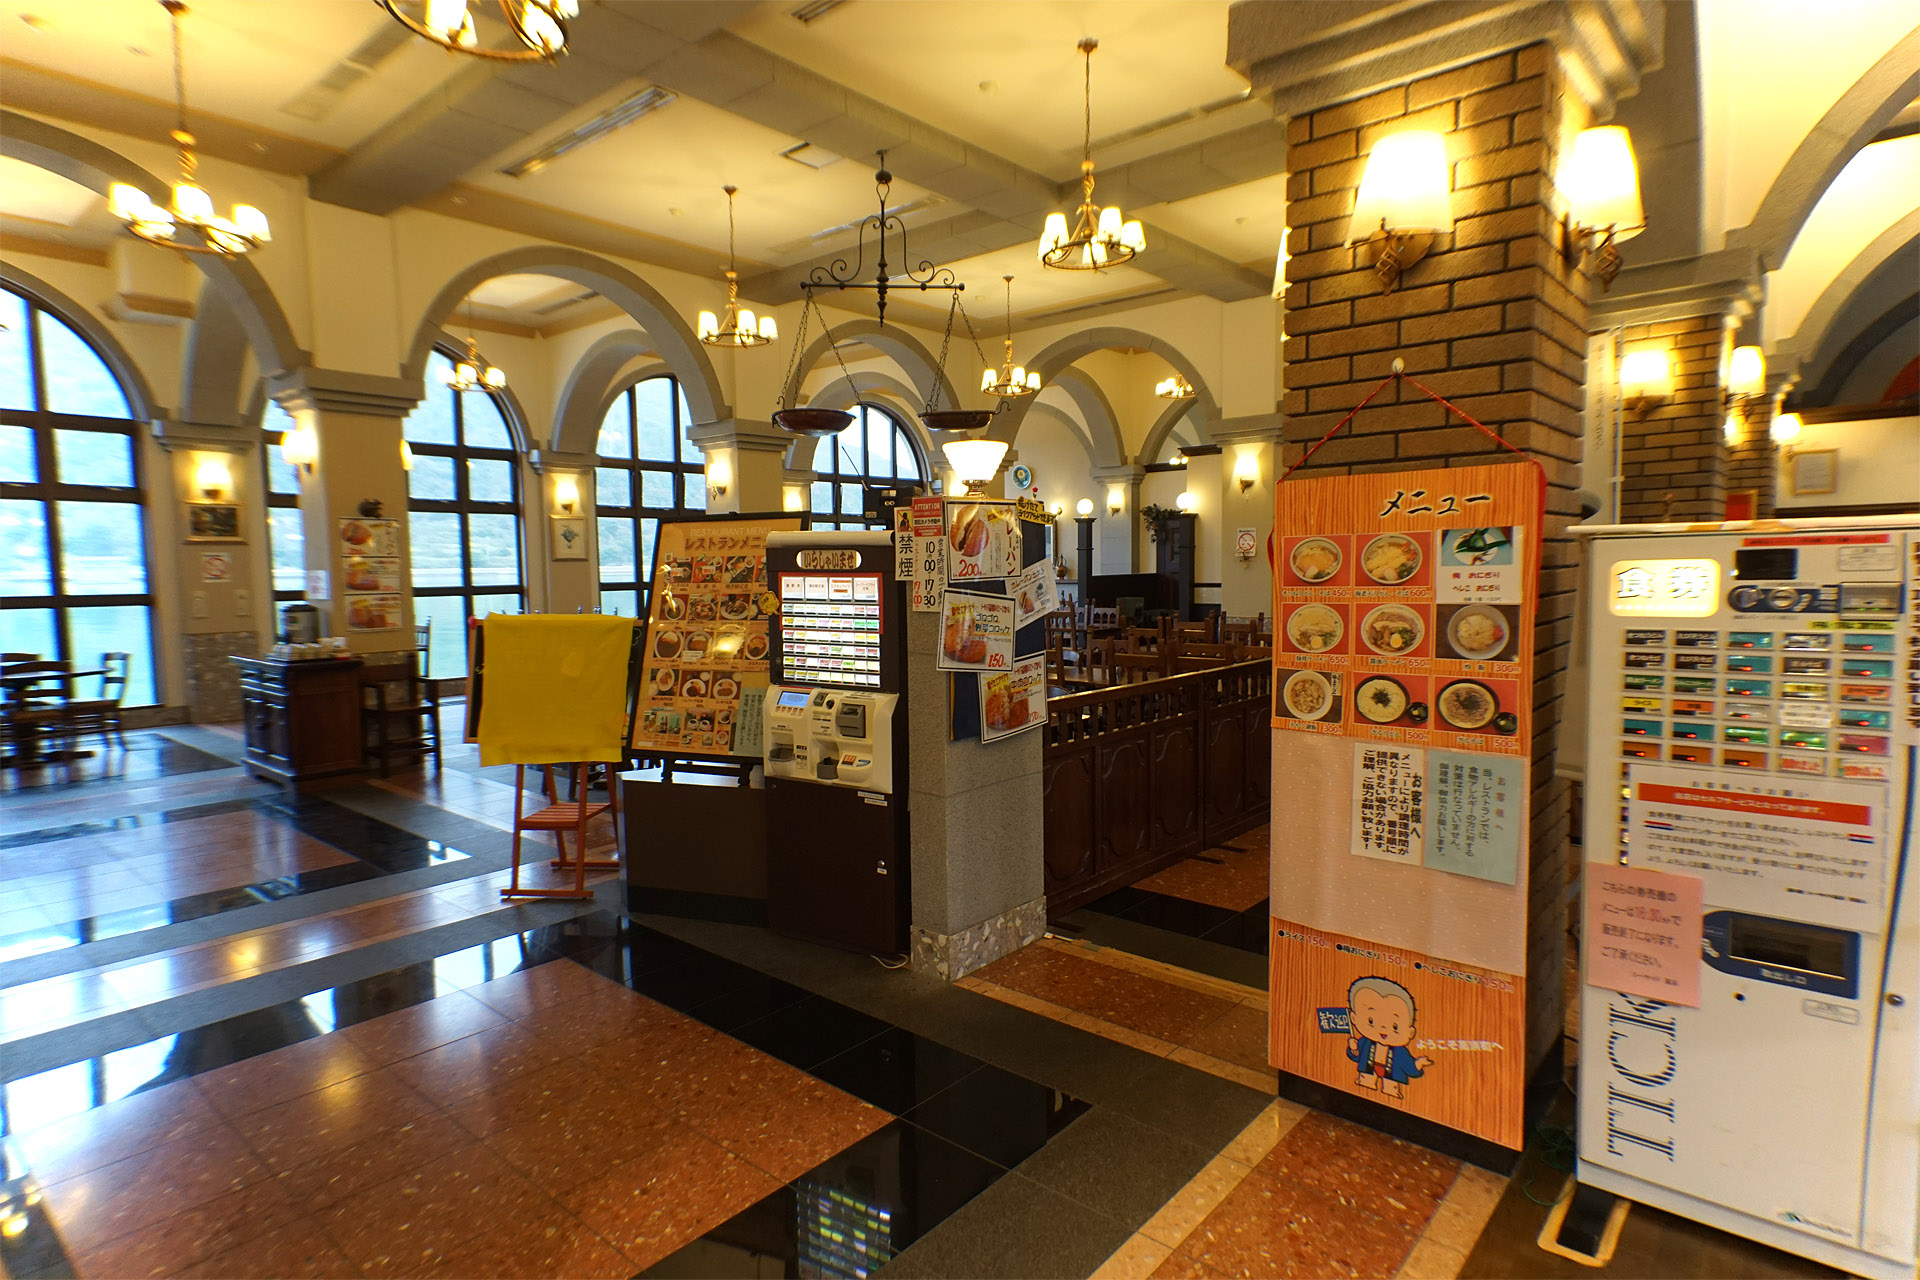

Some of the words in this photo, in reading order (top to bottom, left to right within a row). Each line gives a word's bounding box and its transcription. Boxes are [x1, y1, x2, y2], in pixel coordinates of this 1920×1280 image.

[914, 503, 940, 511] ATTENTION
[1380, 490, 1492, 516] メニュー
[899, 534, 913, 577] 禁煙
[1616, 567, 1709, 599] 食券
[976, 613, 999, 622] ゴロゴロ
[976, 624, 1011, 634] 野菜コロッケ
[1411, 772, 1422, 839] お客様へ
[1285, 931, 1306, 943] ライス
[1319, 1011, 1349, 1030] 歓迎
